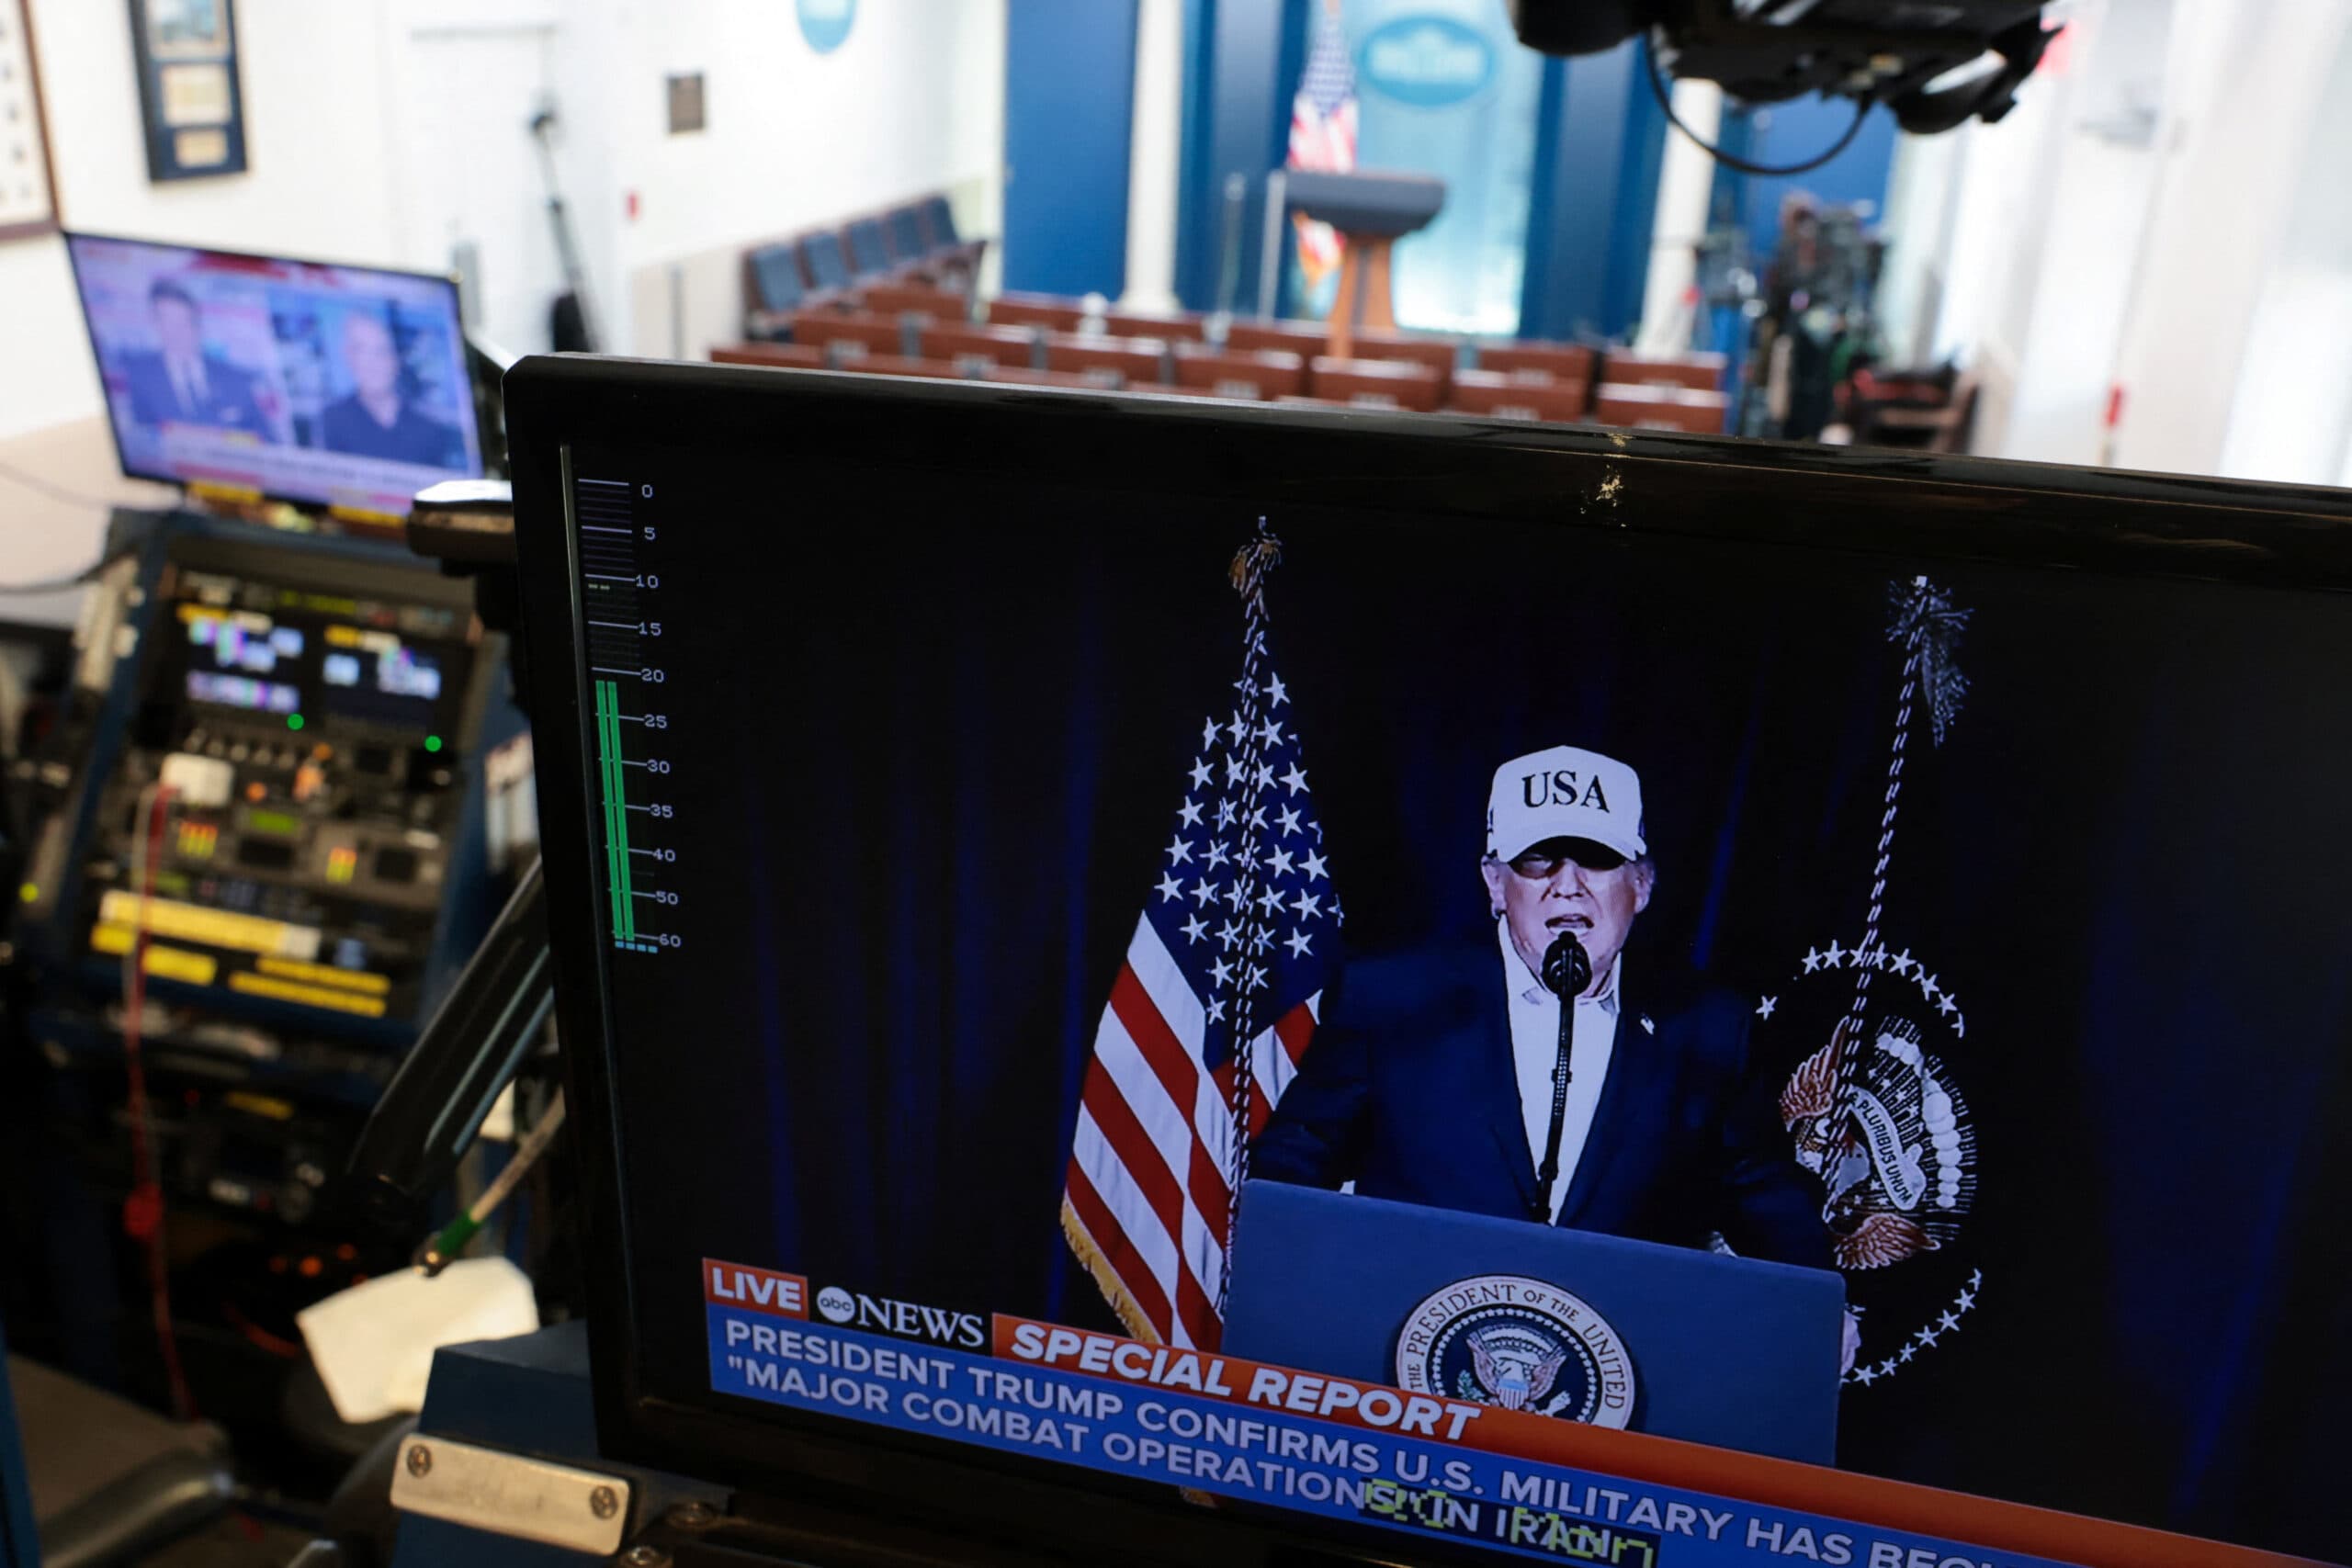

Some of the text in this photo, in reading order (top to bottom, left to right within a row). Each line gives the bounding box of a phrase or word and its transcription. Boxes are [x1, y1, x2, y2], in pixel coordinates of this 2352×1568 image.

[641, 484, 653, 498] 0
[644, 526, 656, 540] 5
[635, 574, 659, 589] 10
[638, 622, 662, 637] 15
[641, 669, 664, 682] 20
[644, 714, 668, 728] 25
[647, 759, 671, 773] 30
[1521, 770, 1611, 814] USA
[650, 804, 673, 818] 35
[652, 848, 676, 863] 40
[655, 891, 679, 906] 50
[659, 933, 682, 948] 60
[1857, 1099, 1896, 1164] PLURIBUS
[712, 1267, 802, 1312] LIVE
[820, 1293, 984, 1348] abc NEWS
[1407, 1284, 1627, 1410] THE PRESIDENT OF THE UNITED
[1011, 1323, 1482, 1440] SPECIAL REPORT
[725, 1319, 956, 1390] PRESIDENT
[967, 1366, 1124, 1421] TRUMP
[1136, 1402, 1379, 1474] CONFIRMS
[1396, 1450, 1483, 1495] U.S.
[1500, 1471, 1734, 1541] MILITARY
[1745, 1517, 1853, 1565] HAS
[727, 1355, 889, 1413] "MAJOR
[901, 1392, 1090, 1452] COMBAT
[1430, 1497, 1479, 1532] IN
[1496, 1509, 1611, 1559] IRAN
